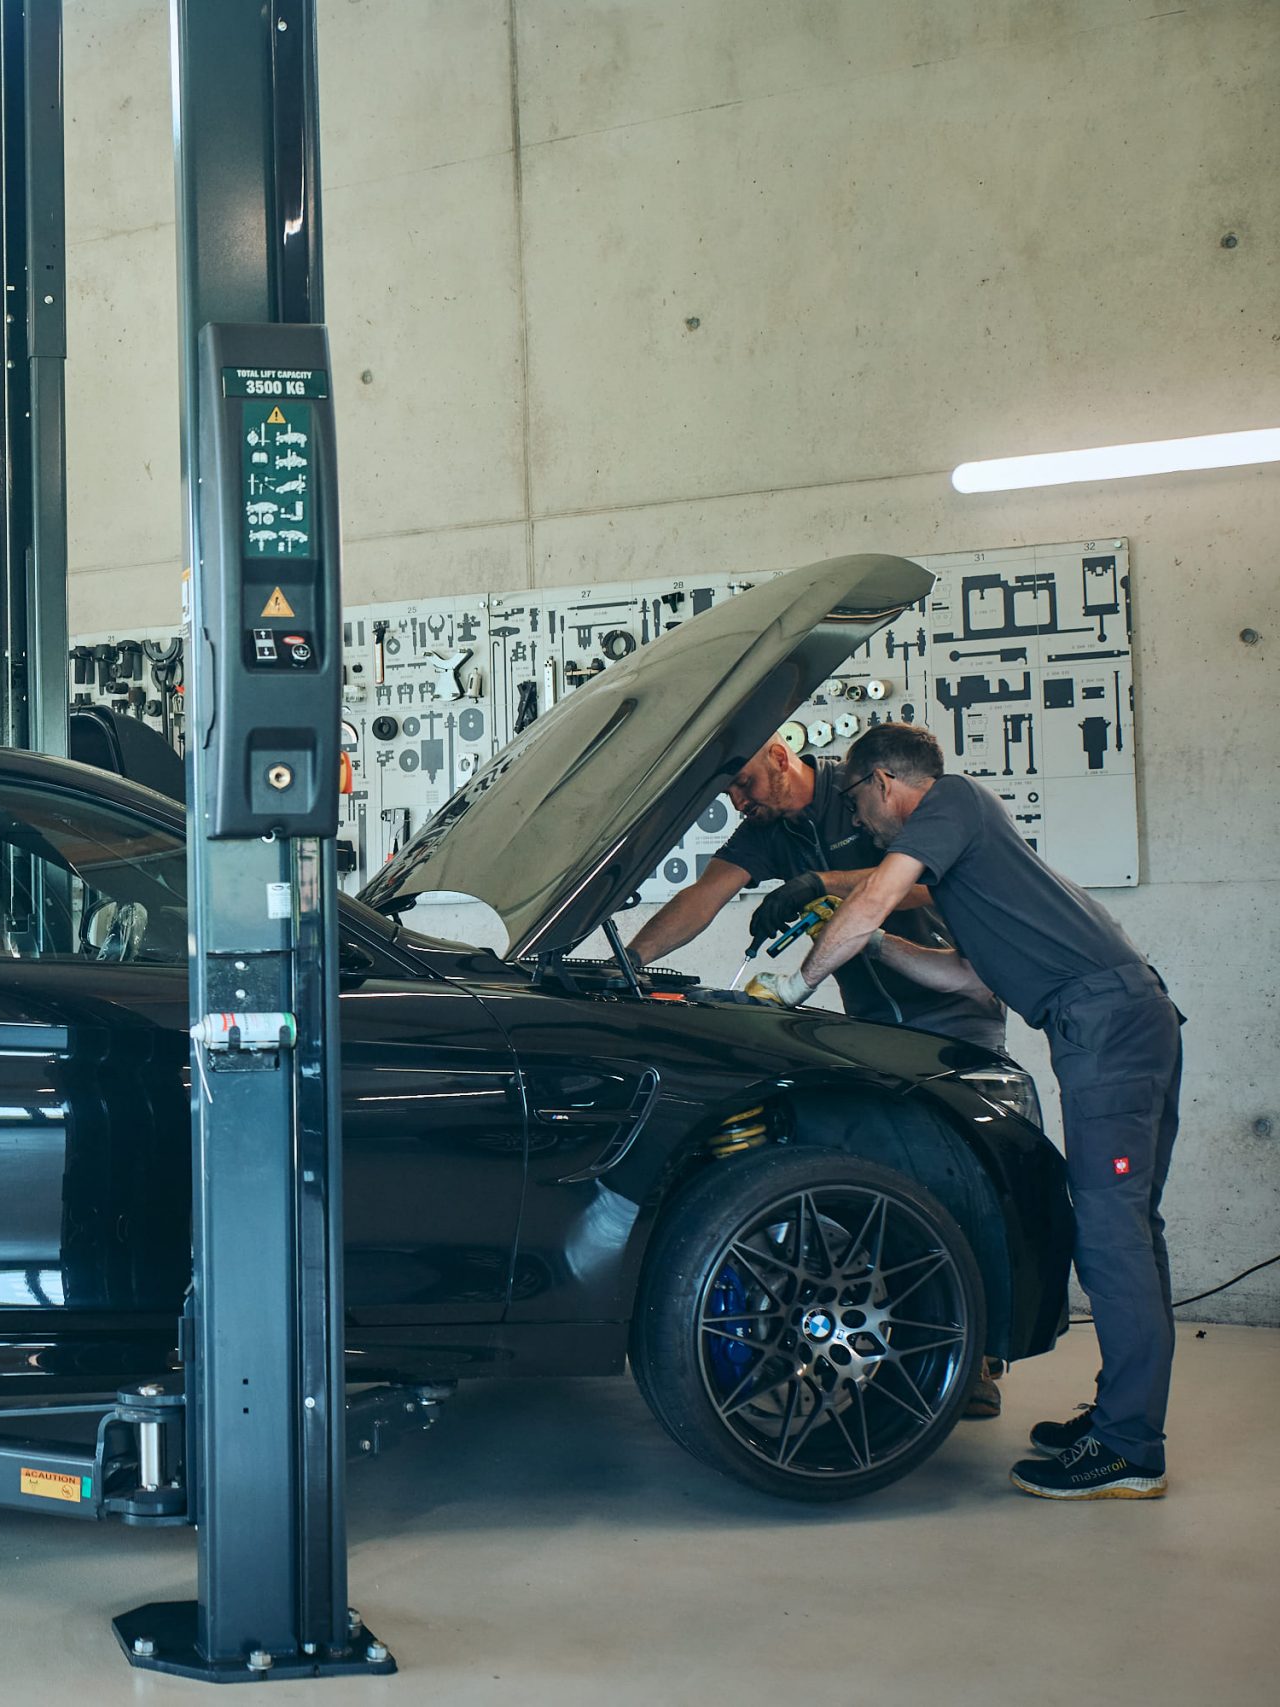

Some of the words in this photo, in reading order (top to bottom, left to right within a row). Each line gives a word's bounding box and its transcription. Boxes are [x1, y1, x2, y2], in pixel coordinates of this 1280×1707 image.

[236, 369, 259, 378] TOTAL
[260, 370, 276, 379] LIFT
[277, 370, 312, 379] CAPACITY
[246, 380, 282, 395] 3500
[286, 381, 305, 395] KG
[1083, 541, 1096, 551] 32
[974, 553, 985, 562] 31
[581, 590, 591, 598] 27
[407, 606, 417, 614] 25
[1071, 1457, 1128, 1483] masteroil
[31, 1471, 76, 1485] CAUTION
